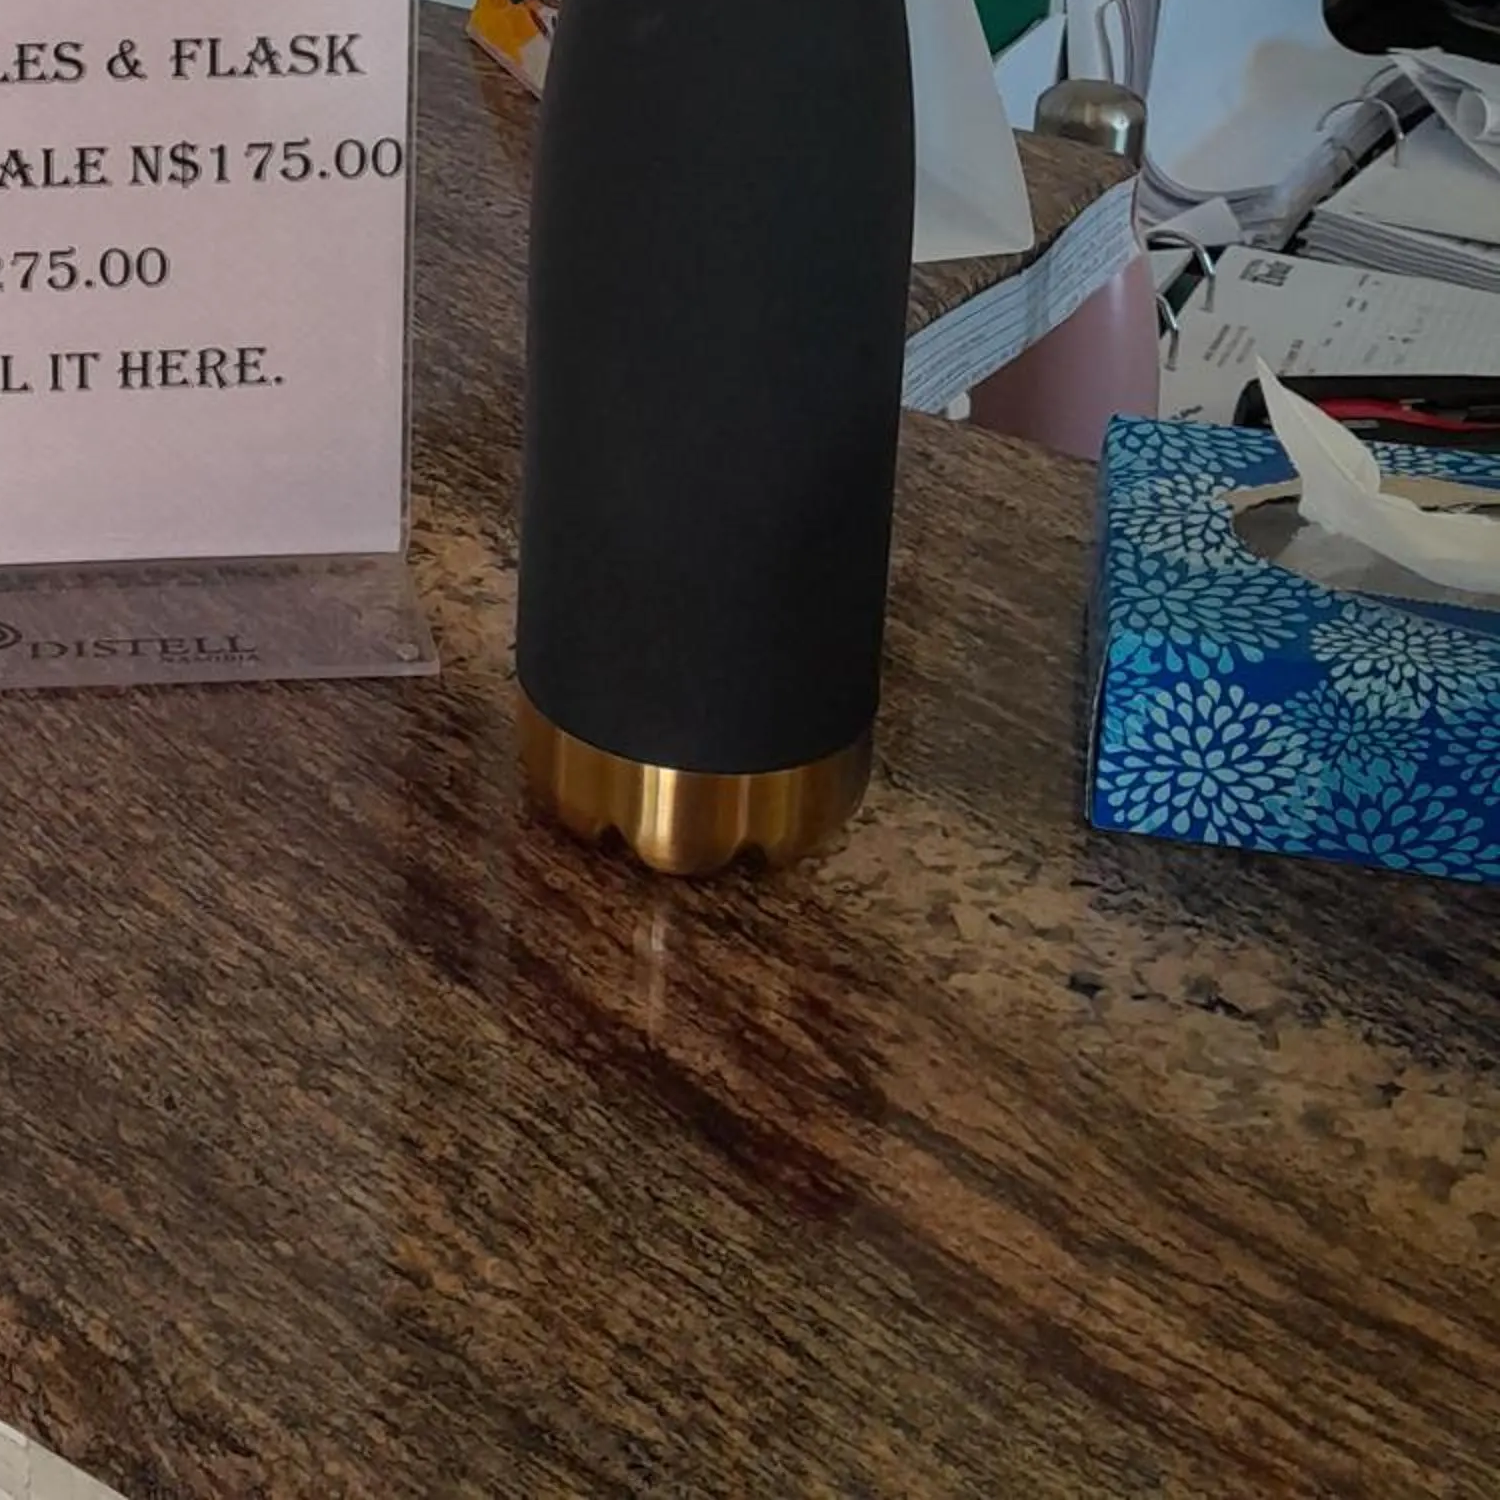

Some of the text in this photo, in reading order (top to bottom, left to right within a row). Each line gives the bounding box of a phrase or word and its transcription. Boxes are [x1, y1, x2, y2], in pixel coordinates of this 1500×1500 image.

[105, 38, 149, 81] &
[169, 33, 368, 80] FLASK
[128, 137, 403, 189] N$175.00
[48, 351, 102, 392] IT
[116, 346, 285, 390] HERE.
[27, 634, 257, 660] DISTELL
